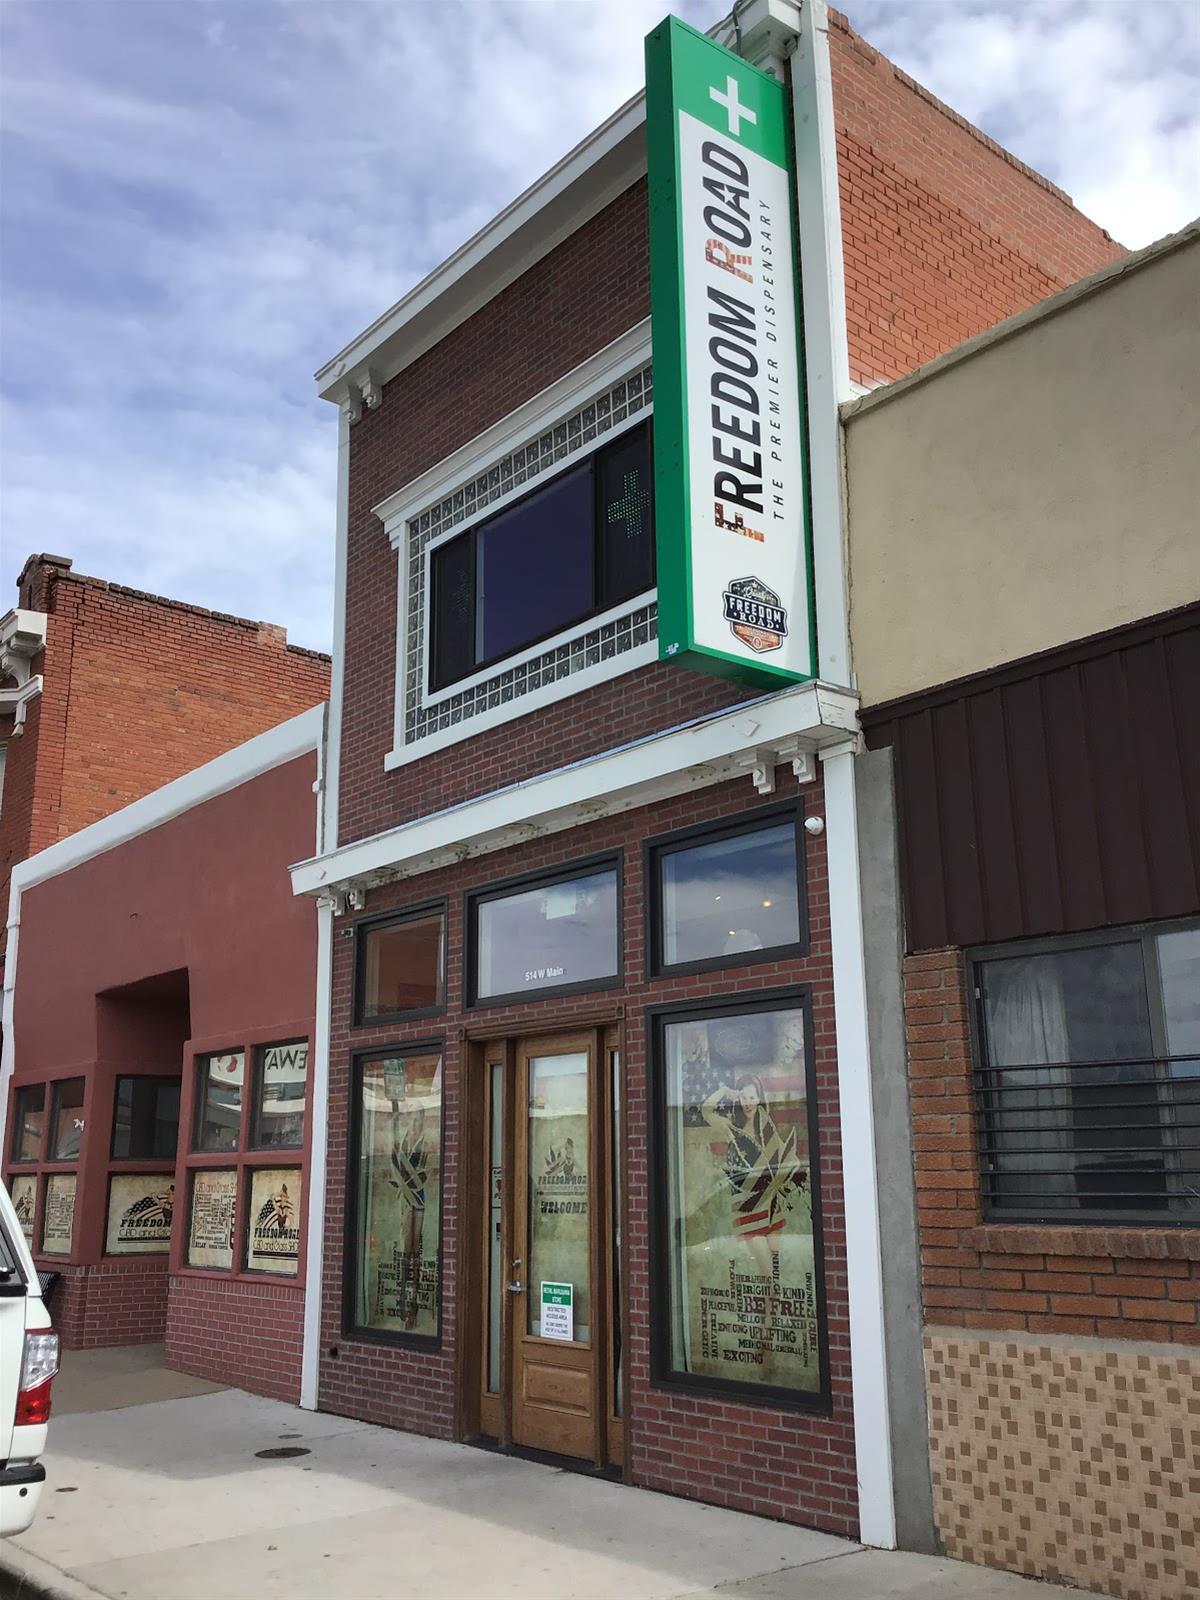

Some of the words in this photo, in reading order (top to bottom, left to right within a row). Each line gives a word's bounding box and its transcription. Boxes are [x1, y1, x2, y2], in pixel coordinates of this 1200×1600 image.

[701, 140, 754, 284] ROAD
[759, 200, 777, 342] DISPENSARY
[706, 285, 765, 543] FREEDOM
[767, 358, 783, 462] PREMIER
[772, 479, 785, 520] THE
[730, 598, 781, 623] FREEDOM
[739, 611, 775, 629] ROAD
[525, 970, 538, 982] 514
[537, 968, 545, 979] W
[546, 966, 568, 978] Main
[541, 1201, 587, 1214] WELCOME
[119, 1219, 171, 1228] FREEDOM
[119, 1228, 138, 1237] CBD
[253, 1227, 283, 1239] FREEDOM
[253, 1239, 263, 1250] CBD
[742, 1284, 771, 1297] BRIGHT
[782, 1287, 806, 1300] KIND
[804, 1272, 814, 1308] UNWIND
[743, 1296, 766, 1315] BE
[769, 1298, 806, 1319] FREE
[771, 1317, 807, 1330] RELAXED
[749, 1325, 797, 1344] UPLIFTING
[738, 1338, 775, 1353] MEDICINAL
[723, 1349, 764, 1365] EXCITING
